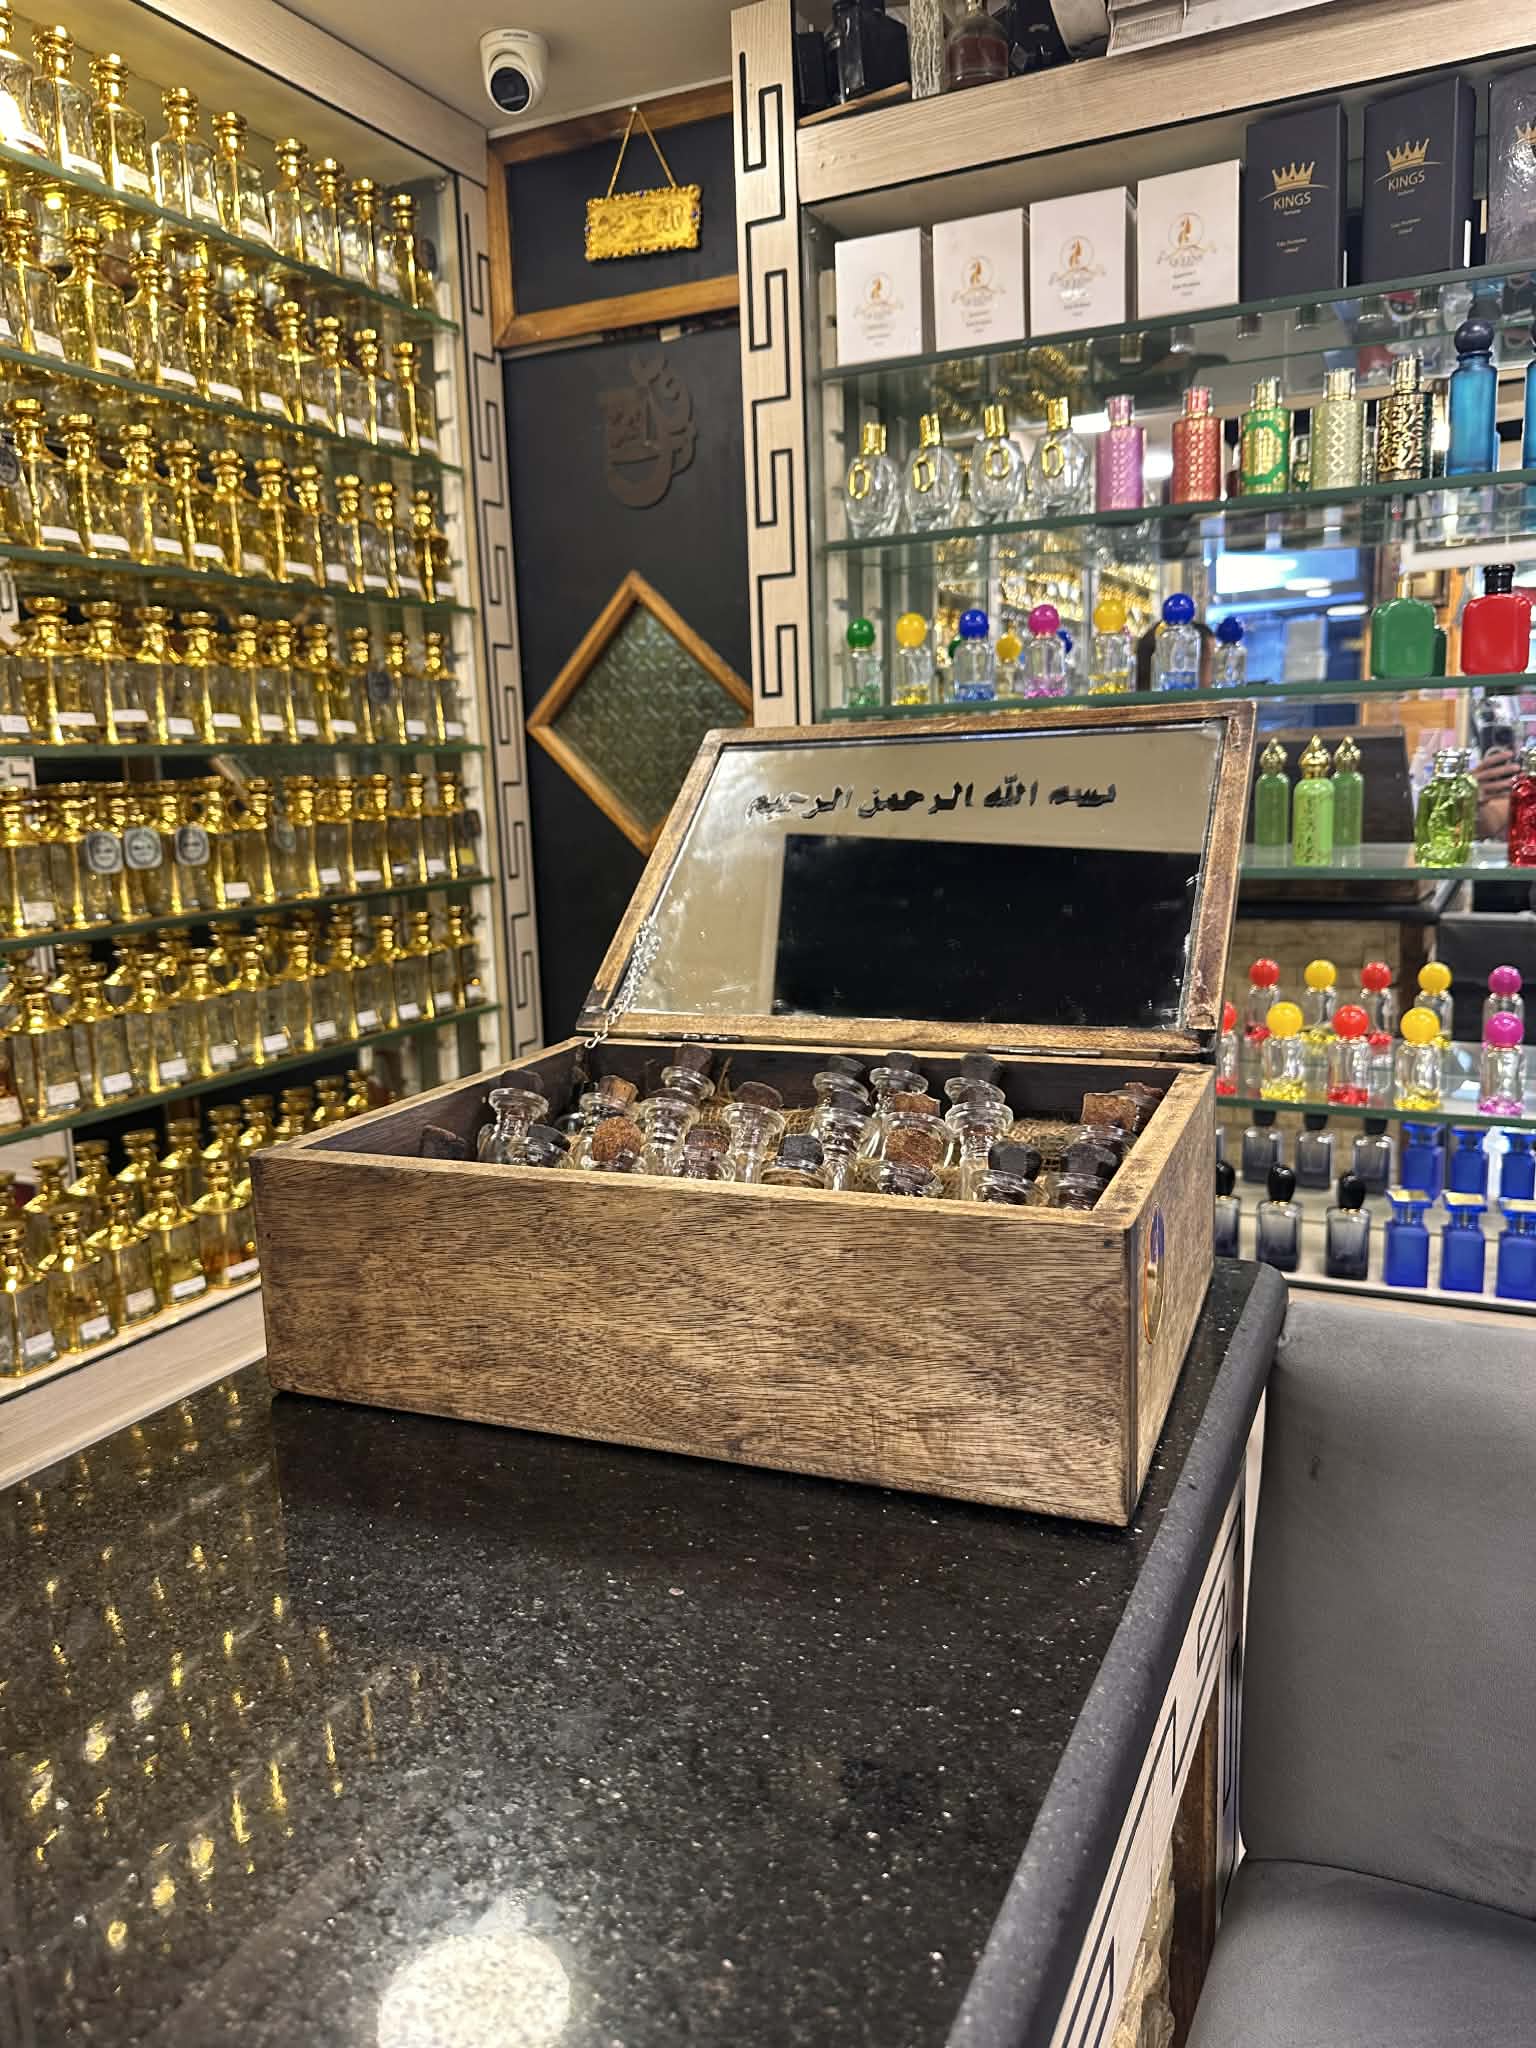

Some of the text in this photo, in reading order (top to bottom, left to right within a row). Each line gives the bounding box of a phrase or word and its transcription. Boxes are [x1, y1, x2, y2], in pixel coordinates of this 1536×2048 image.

[1386, 169, 1425, 192] KINGS
[1273, 191, 1312, 210] KINGS
[744, 784, 854, 824] الرحيم
[857, 780, 975, 819] الرحمن
[983, 771, 1039, 808] الله
